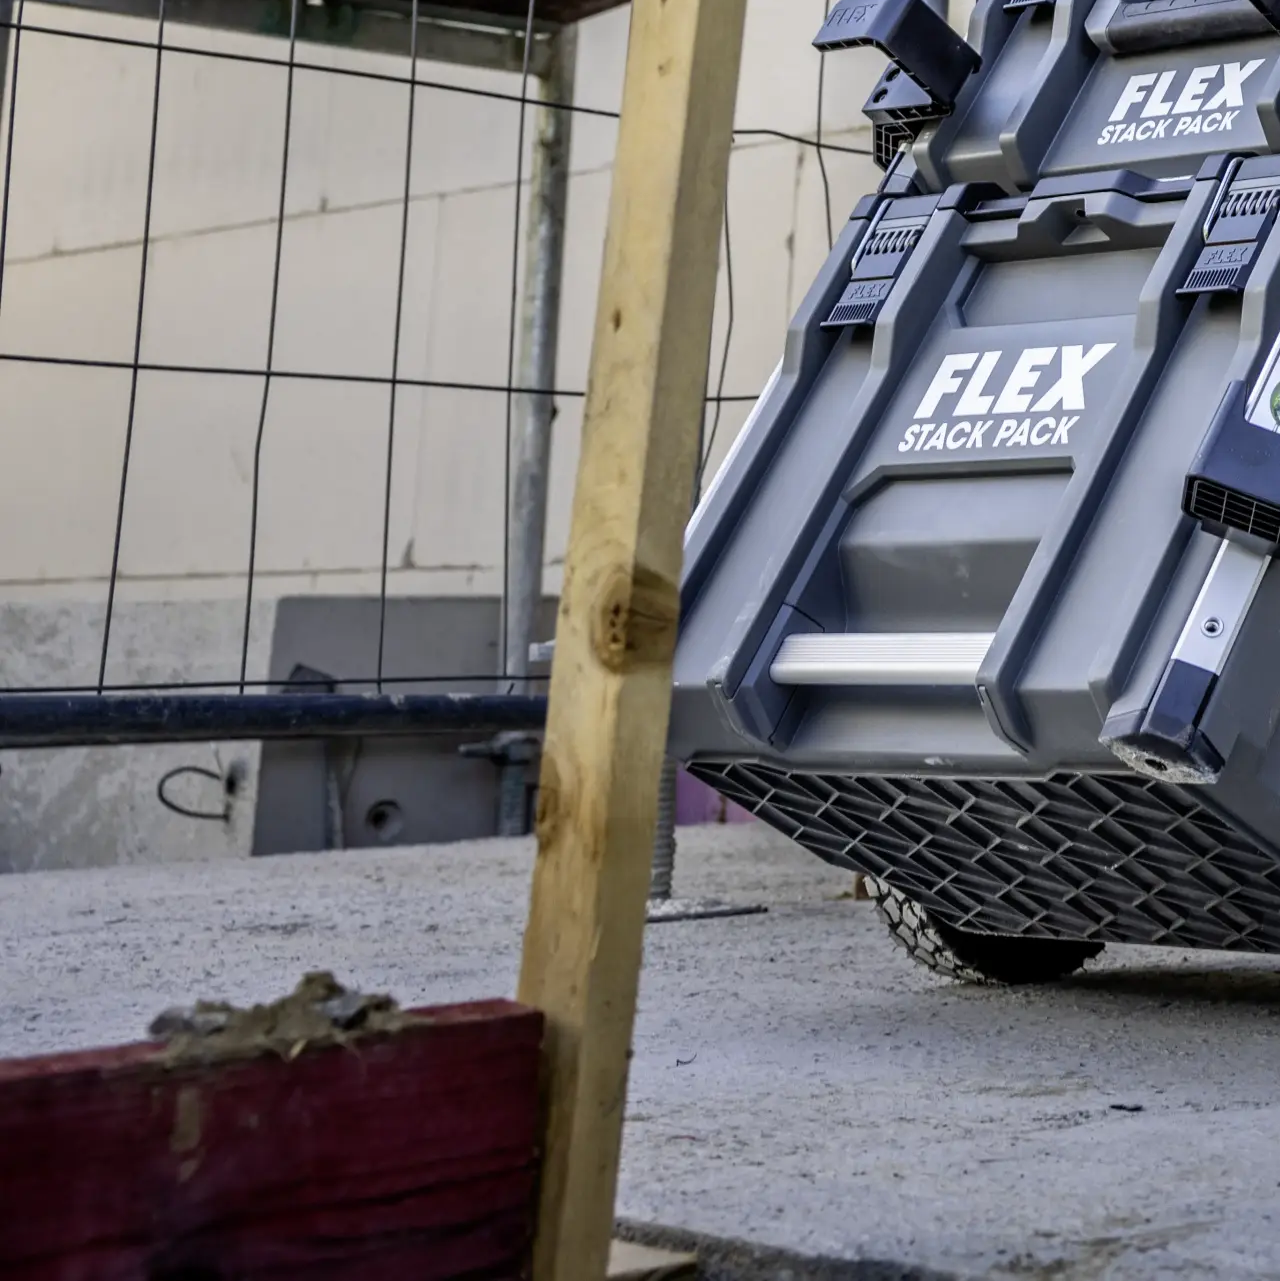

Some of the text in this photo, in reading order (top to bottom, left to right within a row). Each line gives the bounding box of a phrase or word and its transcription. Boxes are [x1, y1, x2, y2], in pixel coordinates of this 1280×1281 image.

[1108, 58, 1266, 122] FLEX
[1097, 109, 1242, 146] STACK PACK
[1204, 246, 1249, 265] FLEX
[848, 282, 886, 300] FLEX
[913, 342, 1118, 420] FLEX
[898, 415, 1081, 453] STACK PACK
